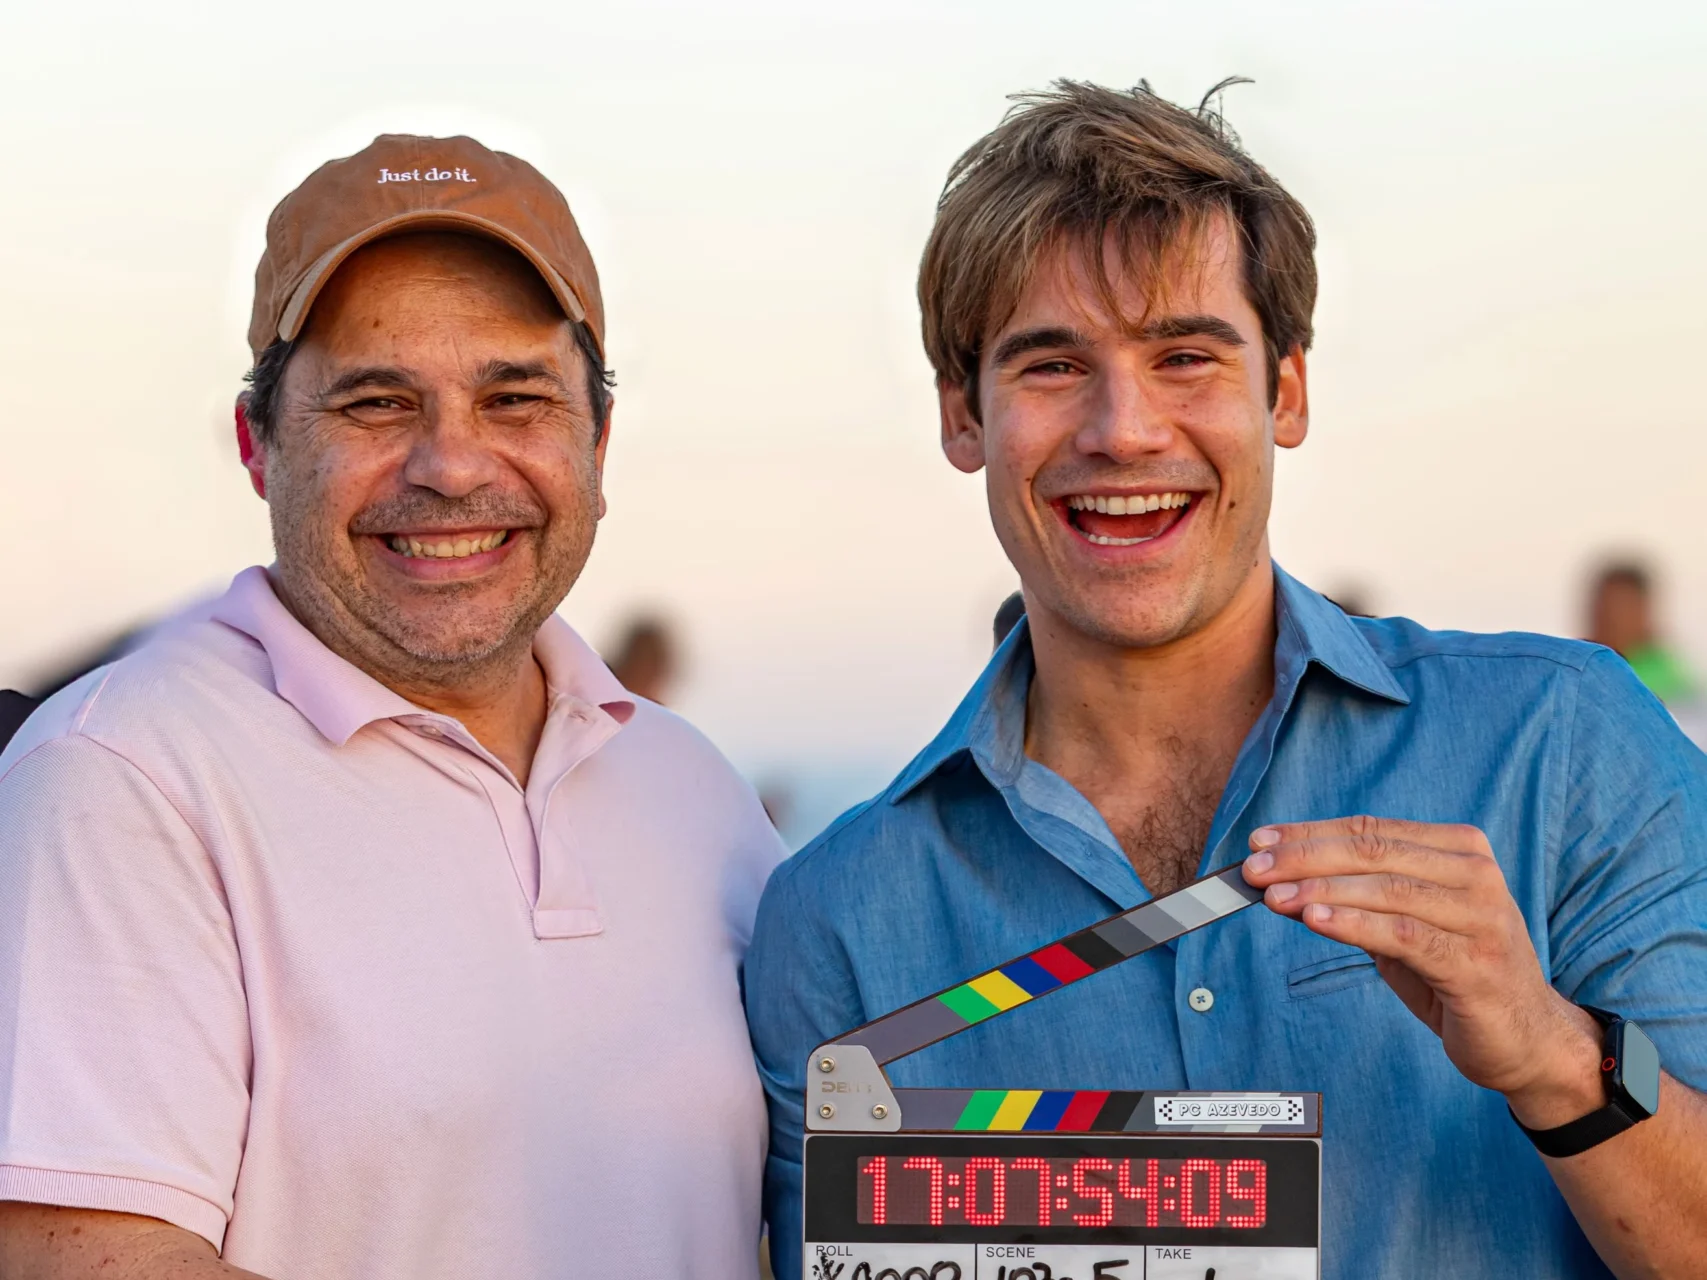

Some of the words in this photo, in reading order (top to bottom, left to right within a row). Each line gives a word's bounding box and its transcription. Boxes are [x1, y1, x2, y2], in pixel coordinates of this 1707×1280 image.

[377, 168, 422, 184] Just
[424, 167, 452, 181] do
[454, 167, 477, 182] it.
[1179, 1103, 1201, 1117] PC
[1207, 1103, 1281, 1117] AZEVEDO
[862, 1156, 1267, 1228] 17:07:54:09
[816, 1245, 853, 1257] ROLL
[986, 1247, 1036, 1258] SCENE
[1155, 1248, 1192, 1260] TAKE
